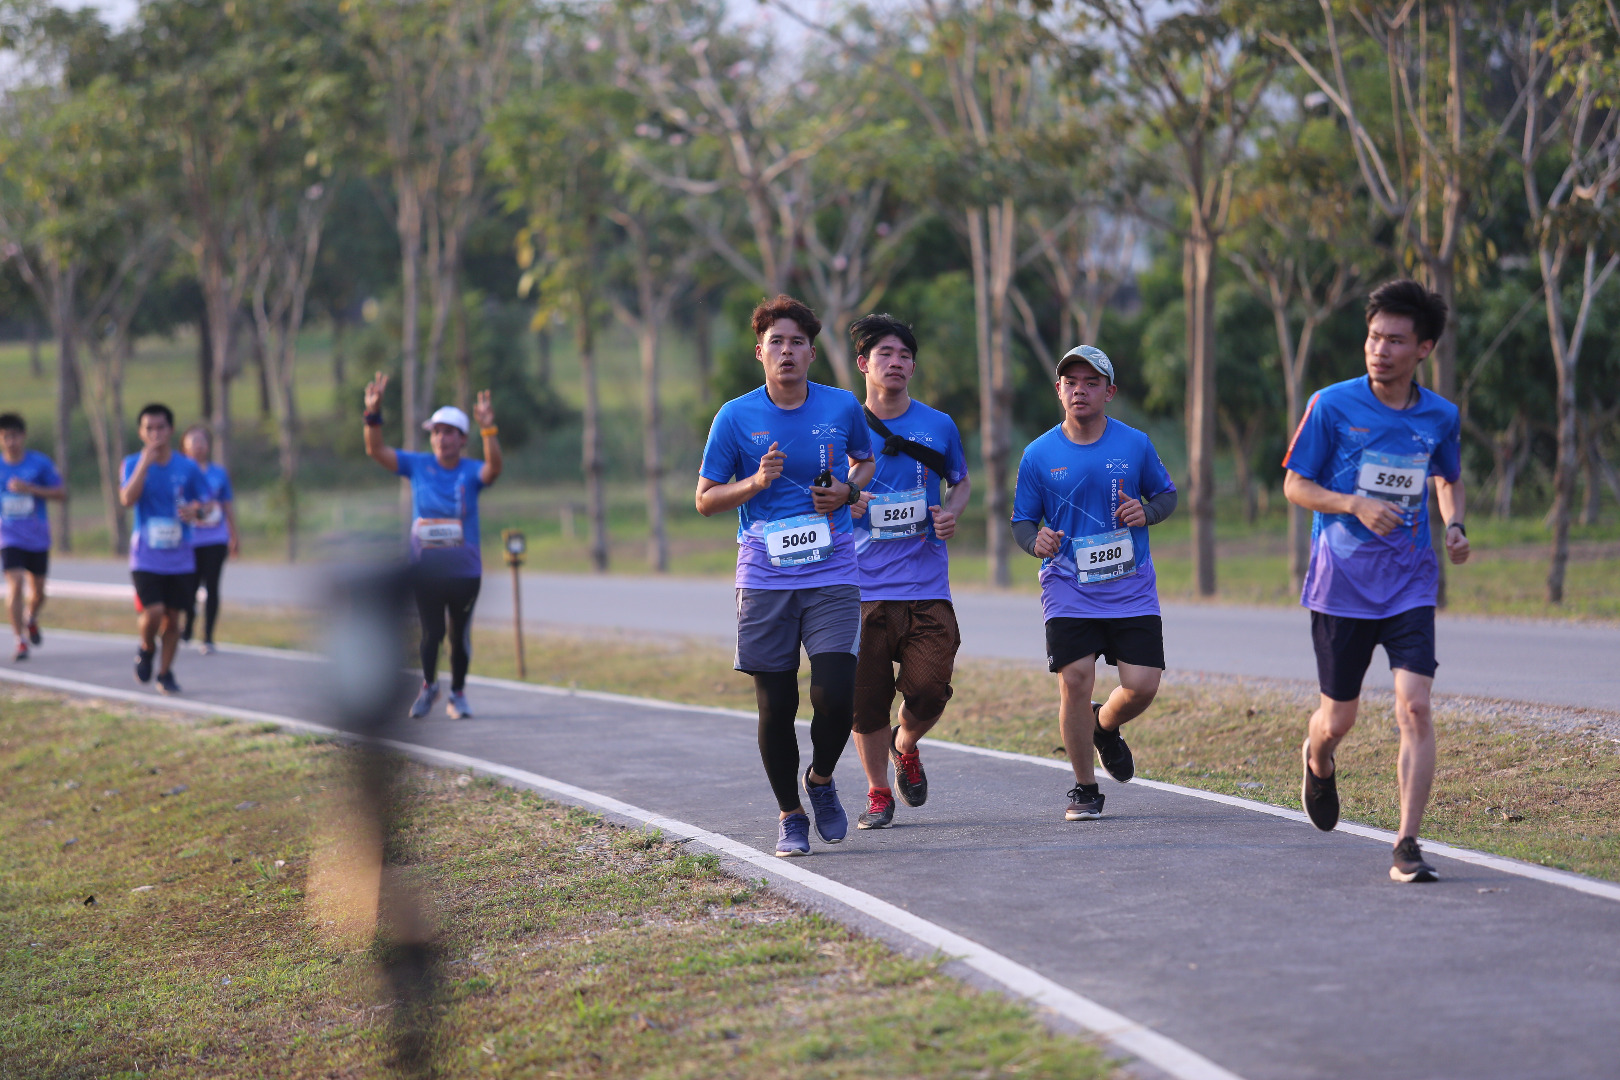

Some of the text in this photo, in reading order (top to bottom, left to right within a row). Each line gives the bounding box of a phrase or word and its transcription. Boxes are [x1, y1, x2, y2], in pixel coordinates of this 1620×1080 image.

[1375, 472, 1413, 489] 5296
[883, 506, 915, 522] 5261
[782, 530, 817, 549] 5060
[1089, 546, 1122, 564] 5280
